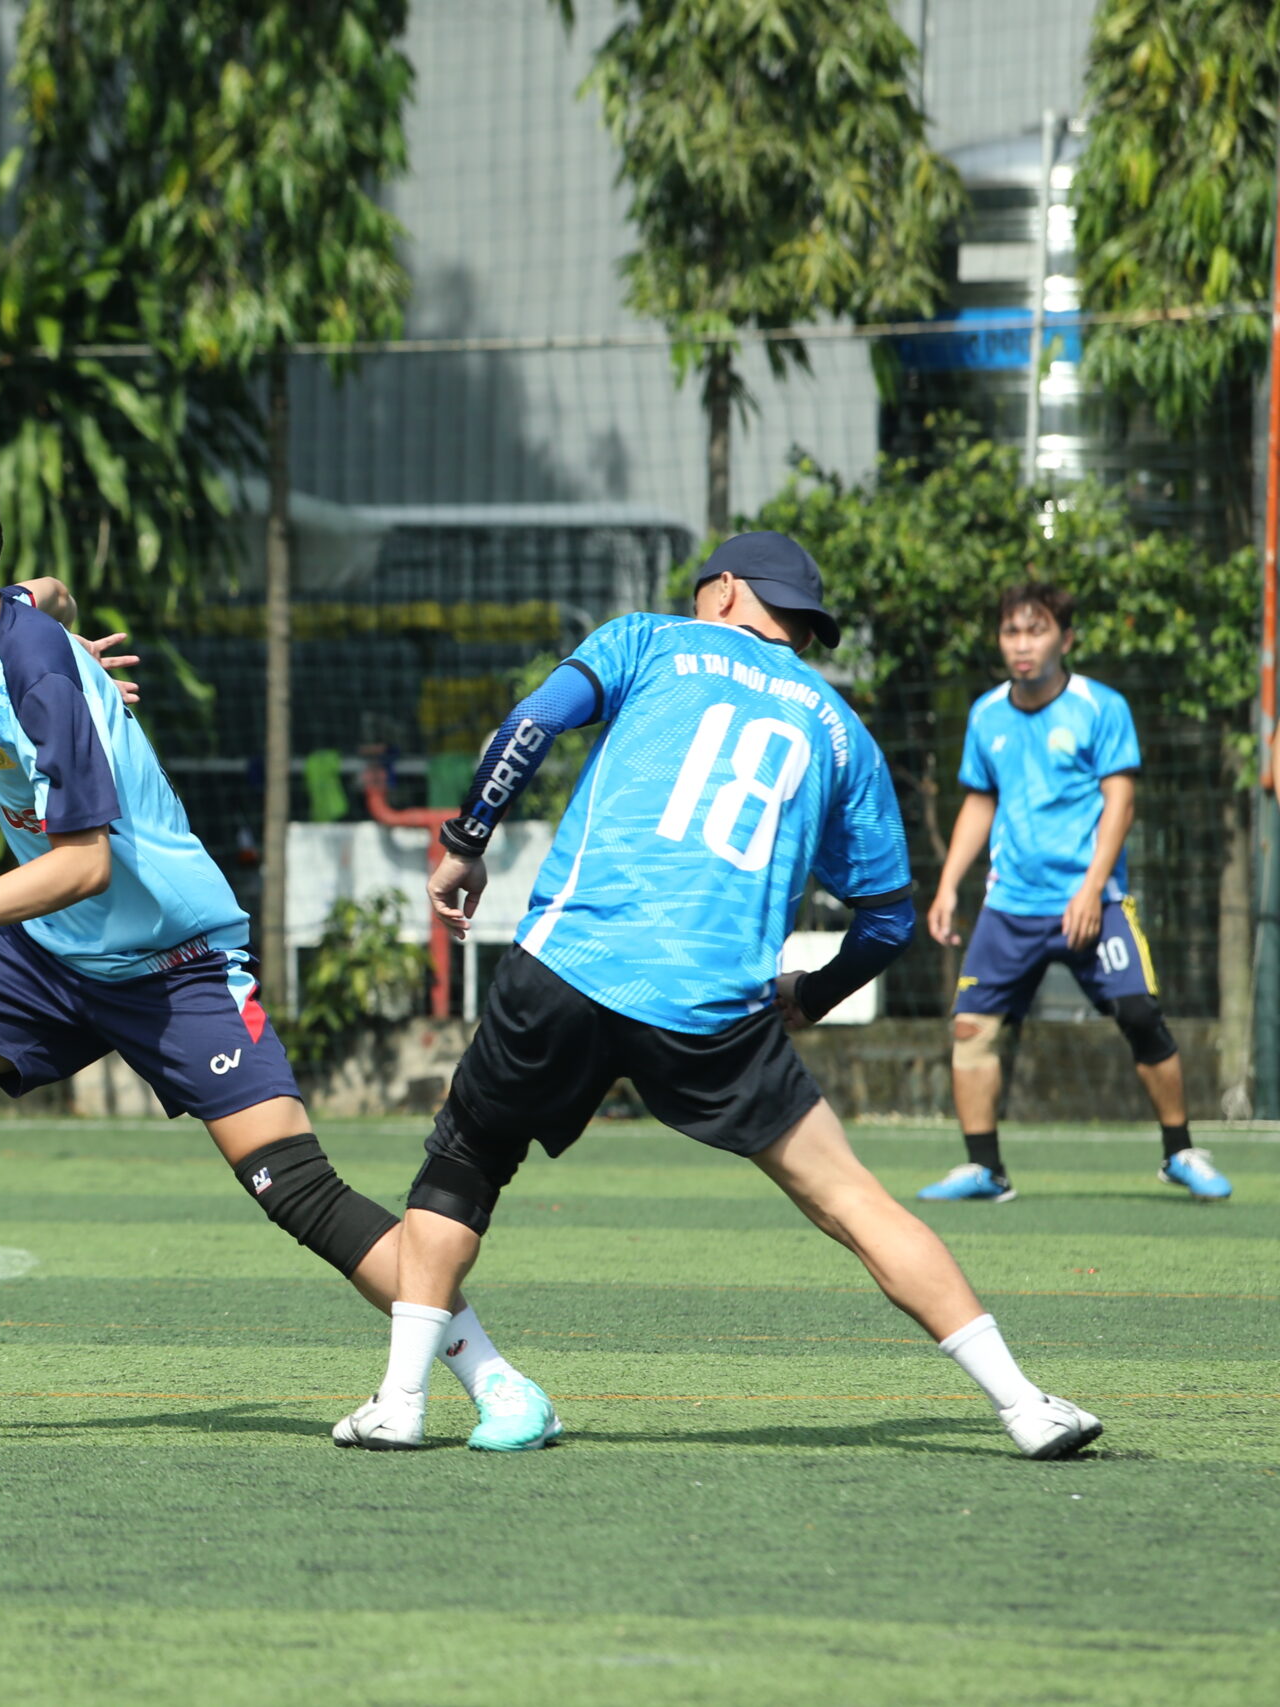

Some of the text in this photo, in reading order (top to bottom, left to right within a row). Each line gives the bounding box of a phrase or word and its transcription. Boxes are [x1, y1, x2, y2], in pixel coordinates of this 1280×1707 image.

[673, 653, 699, 676] BV
[700, 653, 729, 677] TAI
[463, 718, 546, 838] SPORTS
[655, 702, 811, 872] 18
[1096, 936, 1130, 974] 10
